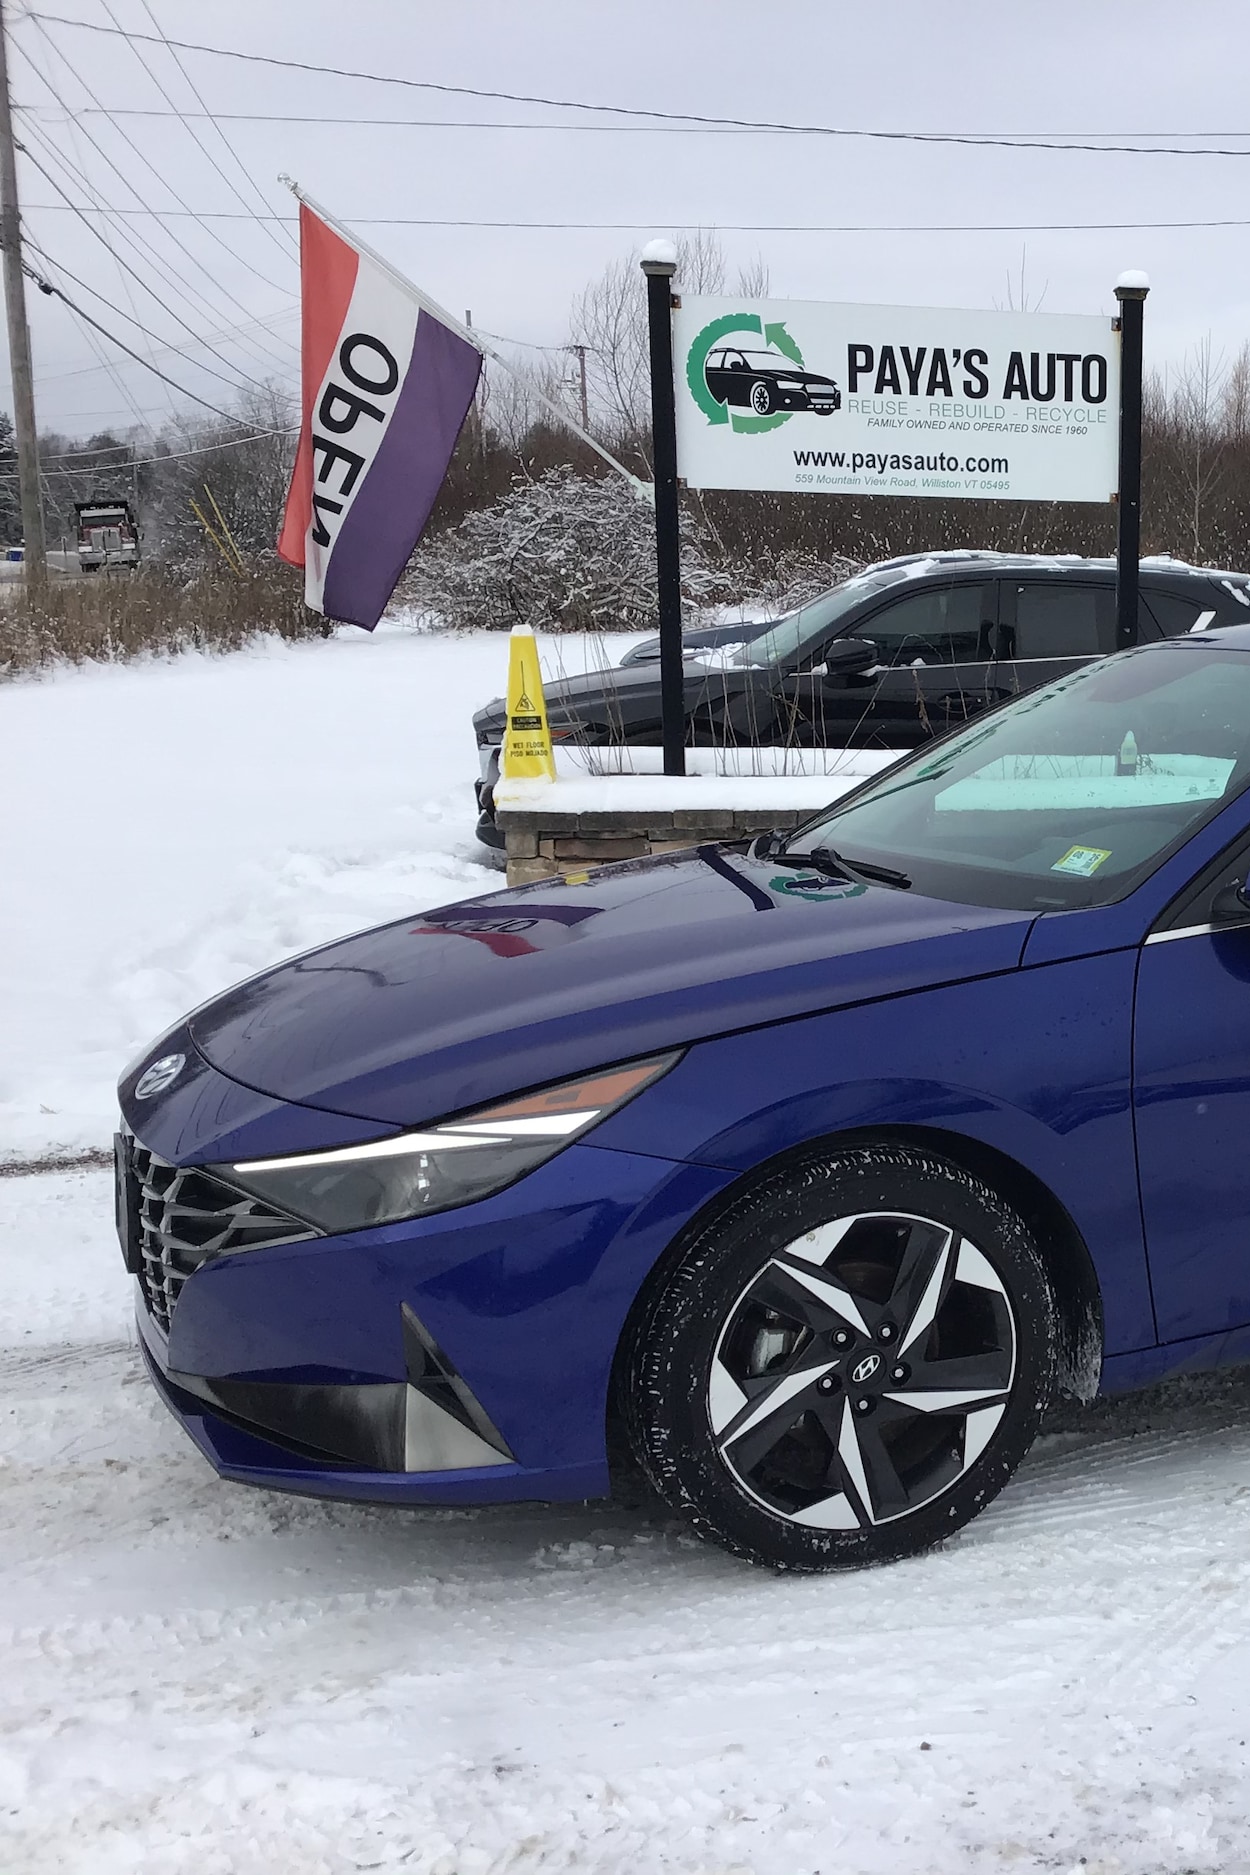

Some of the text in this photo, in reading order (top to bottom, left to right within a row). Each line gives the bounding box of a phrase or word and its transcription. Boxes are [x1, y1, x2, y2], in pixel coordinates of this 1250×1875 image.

[847, 343, 1108, 404] PAYA'S AUTO
[848, 399, 908, 416] REUSE
[929, 402, 1006, 420] REBUILD
[1026, 406, 1107, 424] RECYCLE
[867, 417, 1088, 436] FAMILY OWNED AND OPERATED SINCE 1960
[793, 450, 1009, 475] www.payasauto.com
[795, 473, 1010, 490] 559 Mountain View Road, Williston VT 05495
